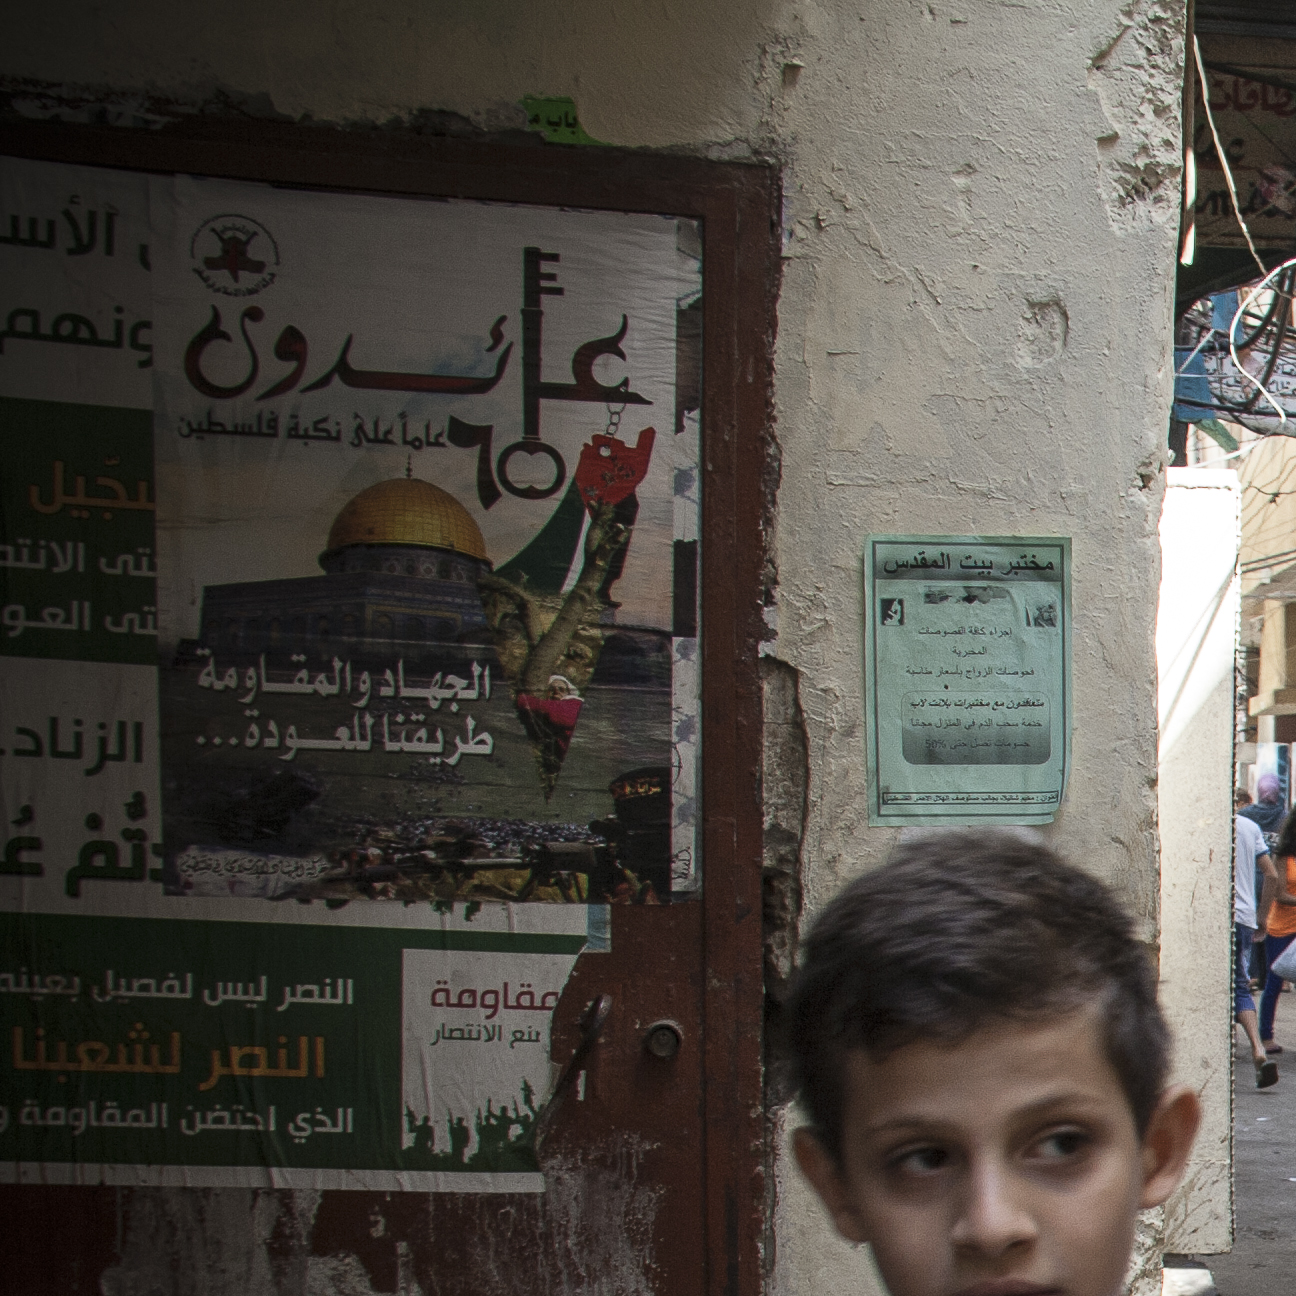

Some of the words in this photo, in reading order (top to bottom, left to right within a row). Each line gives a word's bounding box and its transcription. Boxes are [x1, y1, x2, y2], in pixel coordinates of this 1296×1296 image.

[177, 408, 279, 440] فلسطين
[286, 413, 342, 447] نكبة
[883, 551, 951, 574] المقدس
[959, 554, 993, 576] بيت
[1000, 553, 1055, 576] مختبر
[197, 648, 371, 708] والمقاومة
[379, 658, 491, 713] الجهاد
[383, 712, 494, 766] طريقنا
[90, 969, 193, 1002] لفصيل
[203, 975, 267, 1008] ليس
[276, 978, 354, 1012] النصر
[430, 1022, 502, 1046] الانتصار
[13, 1022, 181, 1084] لشعبنا
[198, 1035, 325, 1092] النصر
[19, 1098, 168, 1136] المقاومة
[179, 1103, 276, 1136] احتضن
[287, 1103, 354, 1144] الذي
